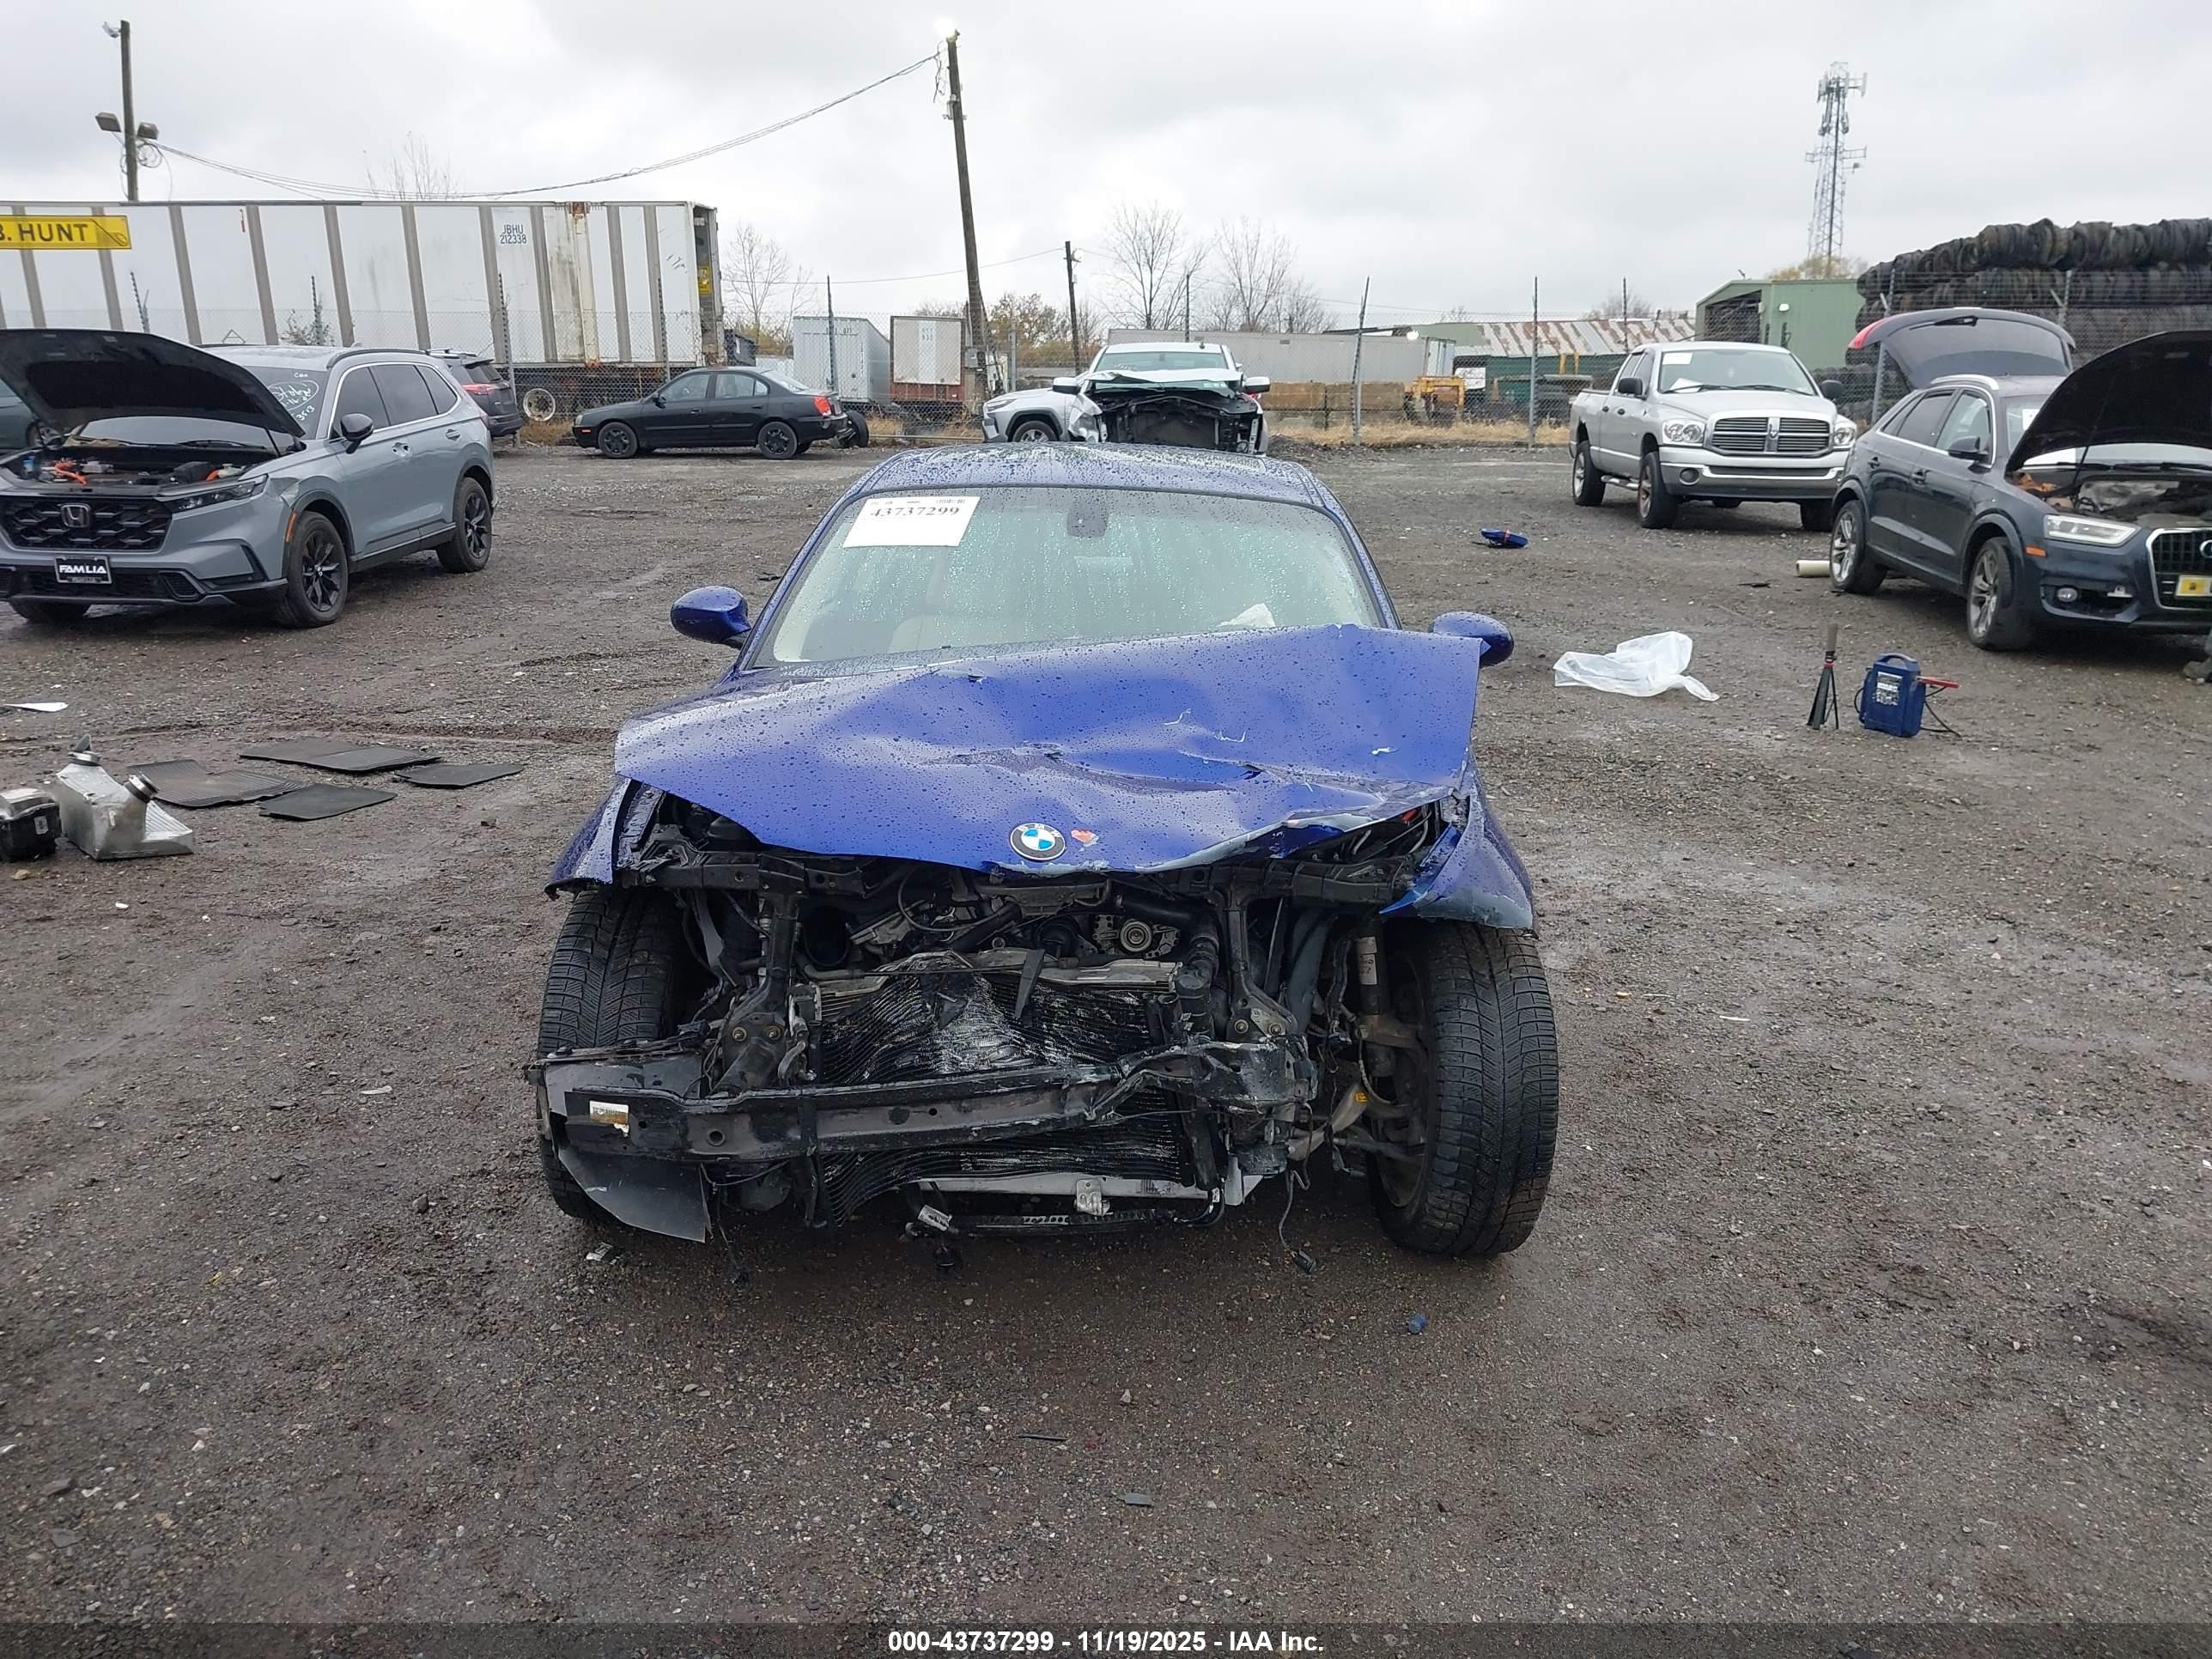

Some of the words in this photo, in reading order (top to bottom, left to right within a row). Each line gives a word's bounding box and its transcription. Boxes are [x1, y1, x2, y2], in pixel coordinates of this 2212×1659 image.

[18, 223, 88, 241] HUNT
[501, 224, 524, 234] JBHU
[500, 234, 527, 244] 212338
[871, 507, 960, 517] 43737299
[1017, 823, 1061, 838] BMW
